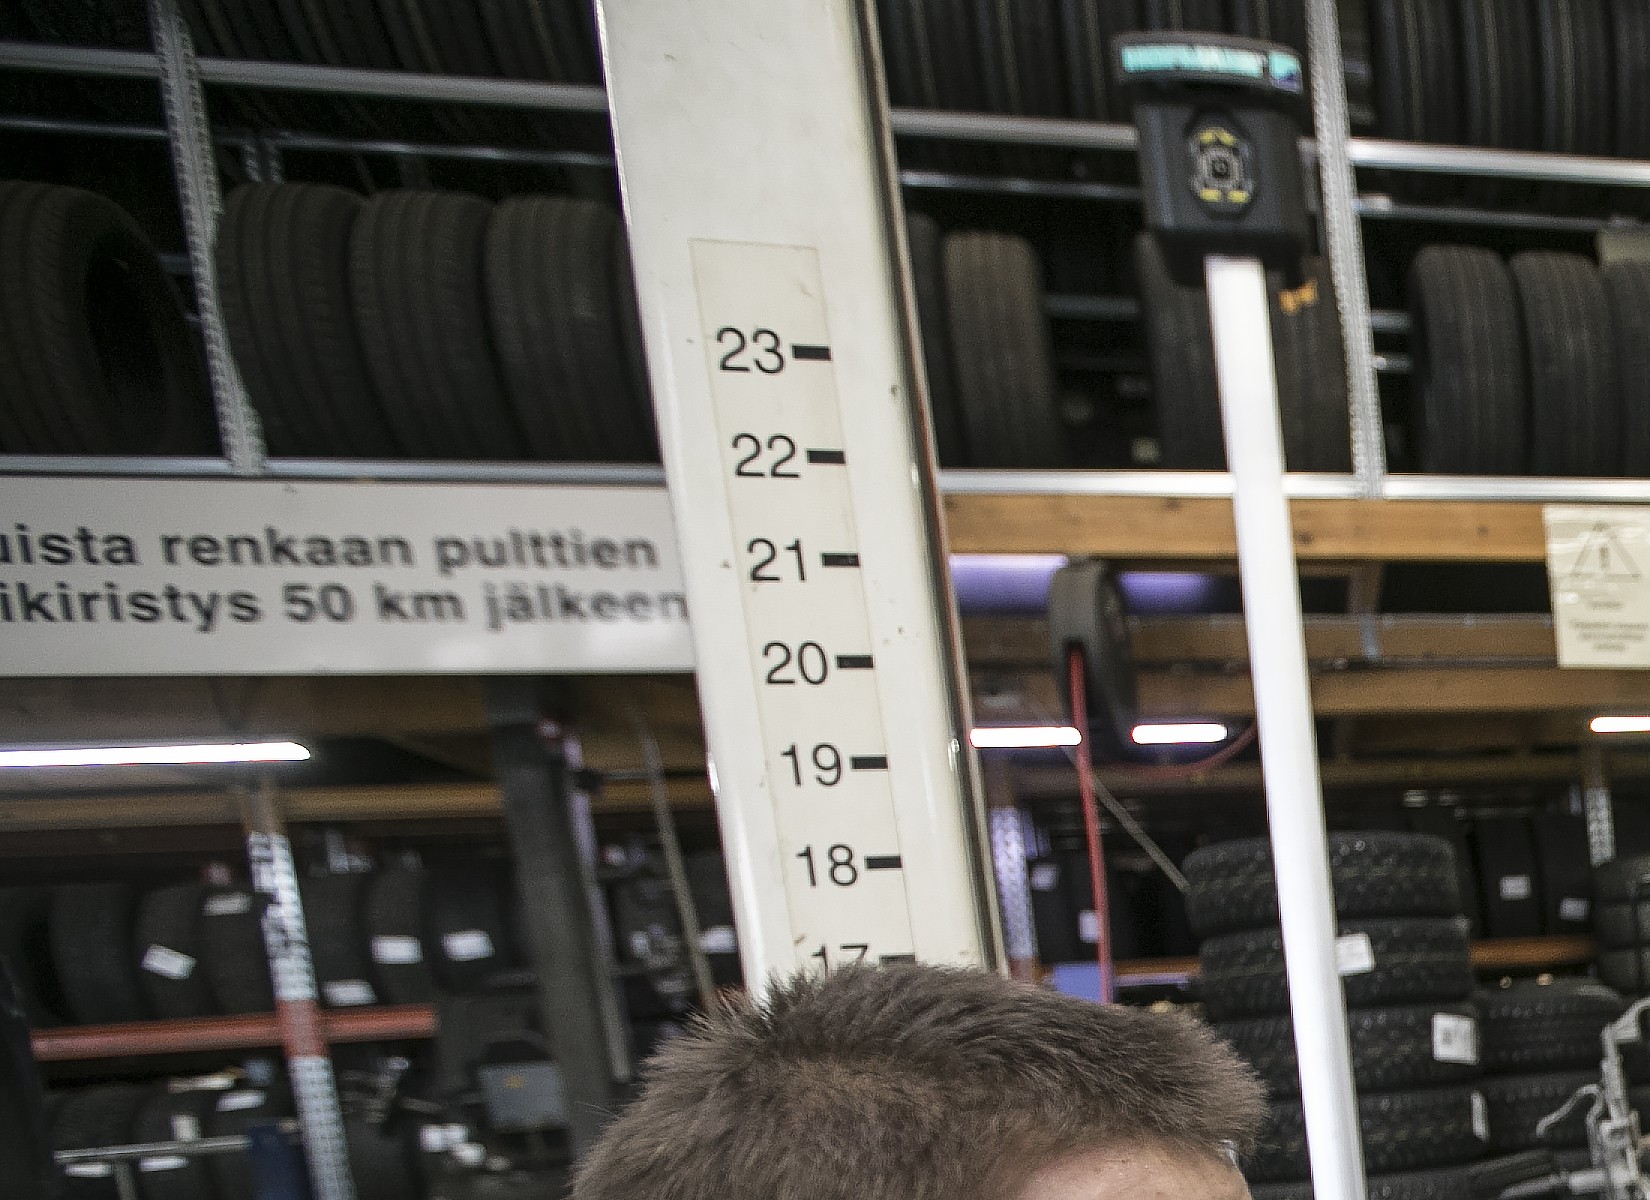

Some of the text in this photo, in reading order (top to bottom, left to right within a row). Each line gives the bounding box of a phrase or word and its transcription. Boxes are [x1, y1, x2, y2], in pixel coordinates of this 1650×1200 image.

[716, 327, 785, 375] 23
[731, 432, 800, 479] 22
[158, 524, 414, 568] renkaan
[434, 526, 661, 577] pulttien
[747, 537, 806, 582] 21
[0, 580, 690, 634] ikiristys 50 km jälkeen
[763, 641, 828, 686] 20
[781, 743, 842, 787] 19
[797, 843, 858, 887] 18
